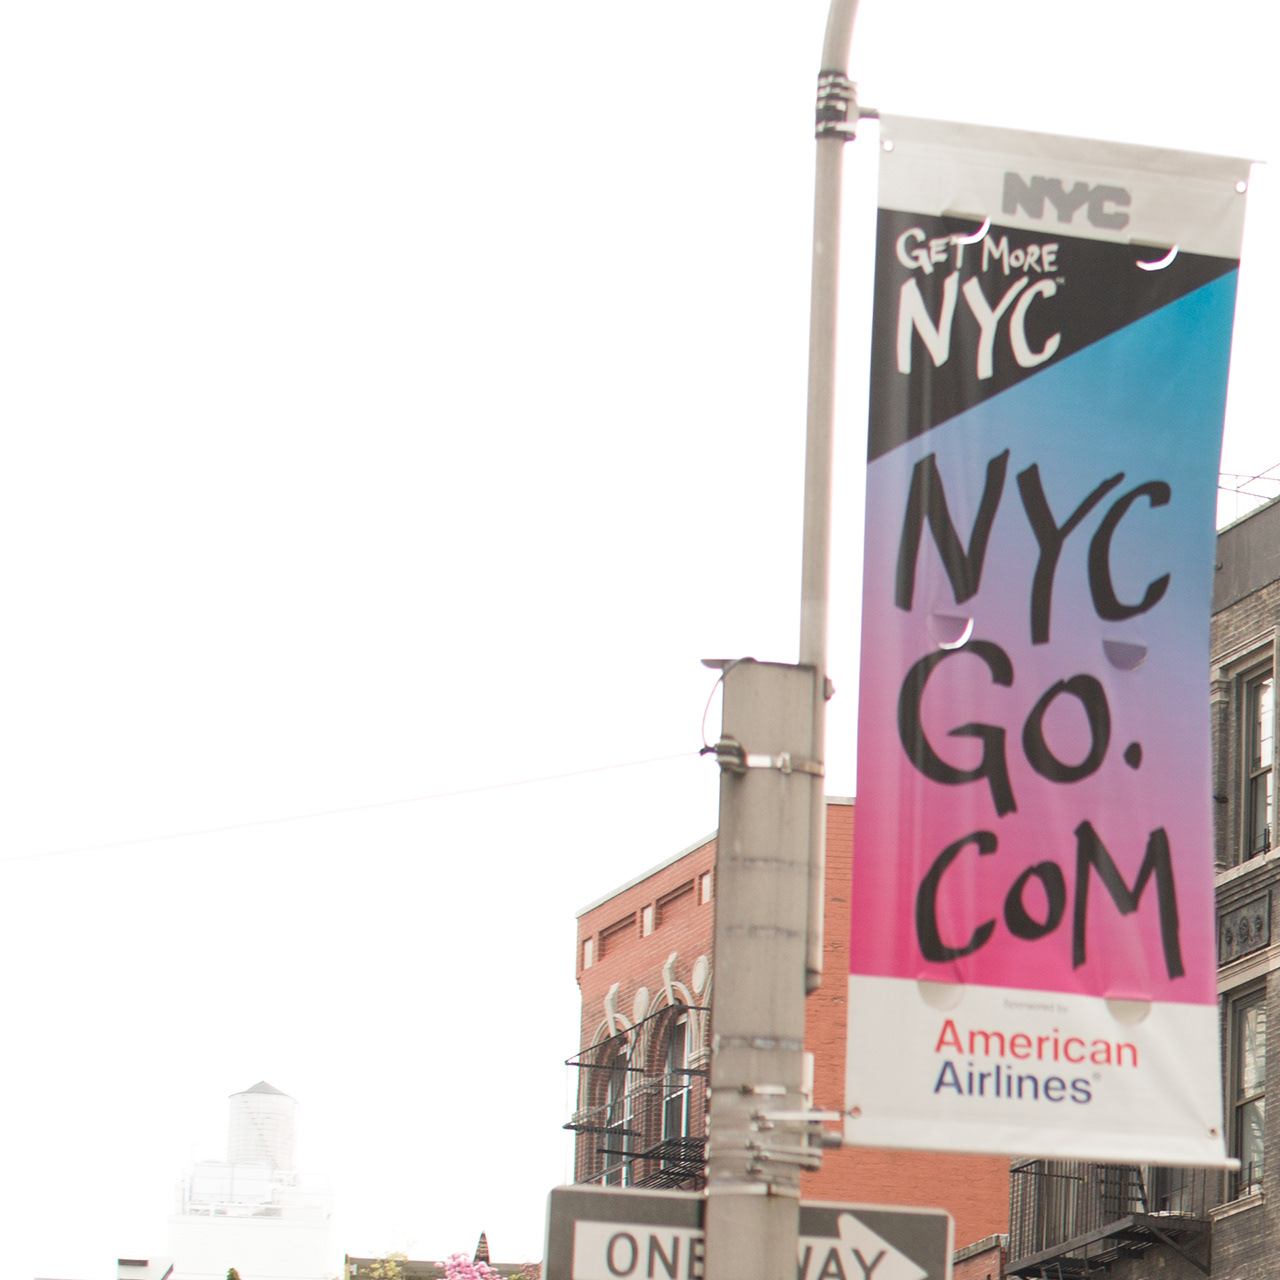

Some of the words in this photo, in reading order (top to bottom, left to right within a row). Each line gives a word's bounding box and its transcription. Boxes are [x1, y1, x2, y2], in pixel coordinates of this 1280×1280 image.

[1002, 171, 1132, 230] NYC
[896, 227, 968, 275] GET
[981, 241, 1058, 273] MORE
[897, 274, 1060, 380] NYC
[895, 449, 1170, 645] NYC
[897, 641, 1142, 816] GO.
[916, 820, 1185, 978] COM
[934, 1060, 1093, 1104] Airlines
[935, 1019, 1139, 1068] American
